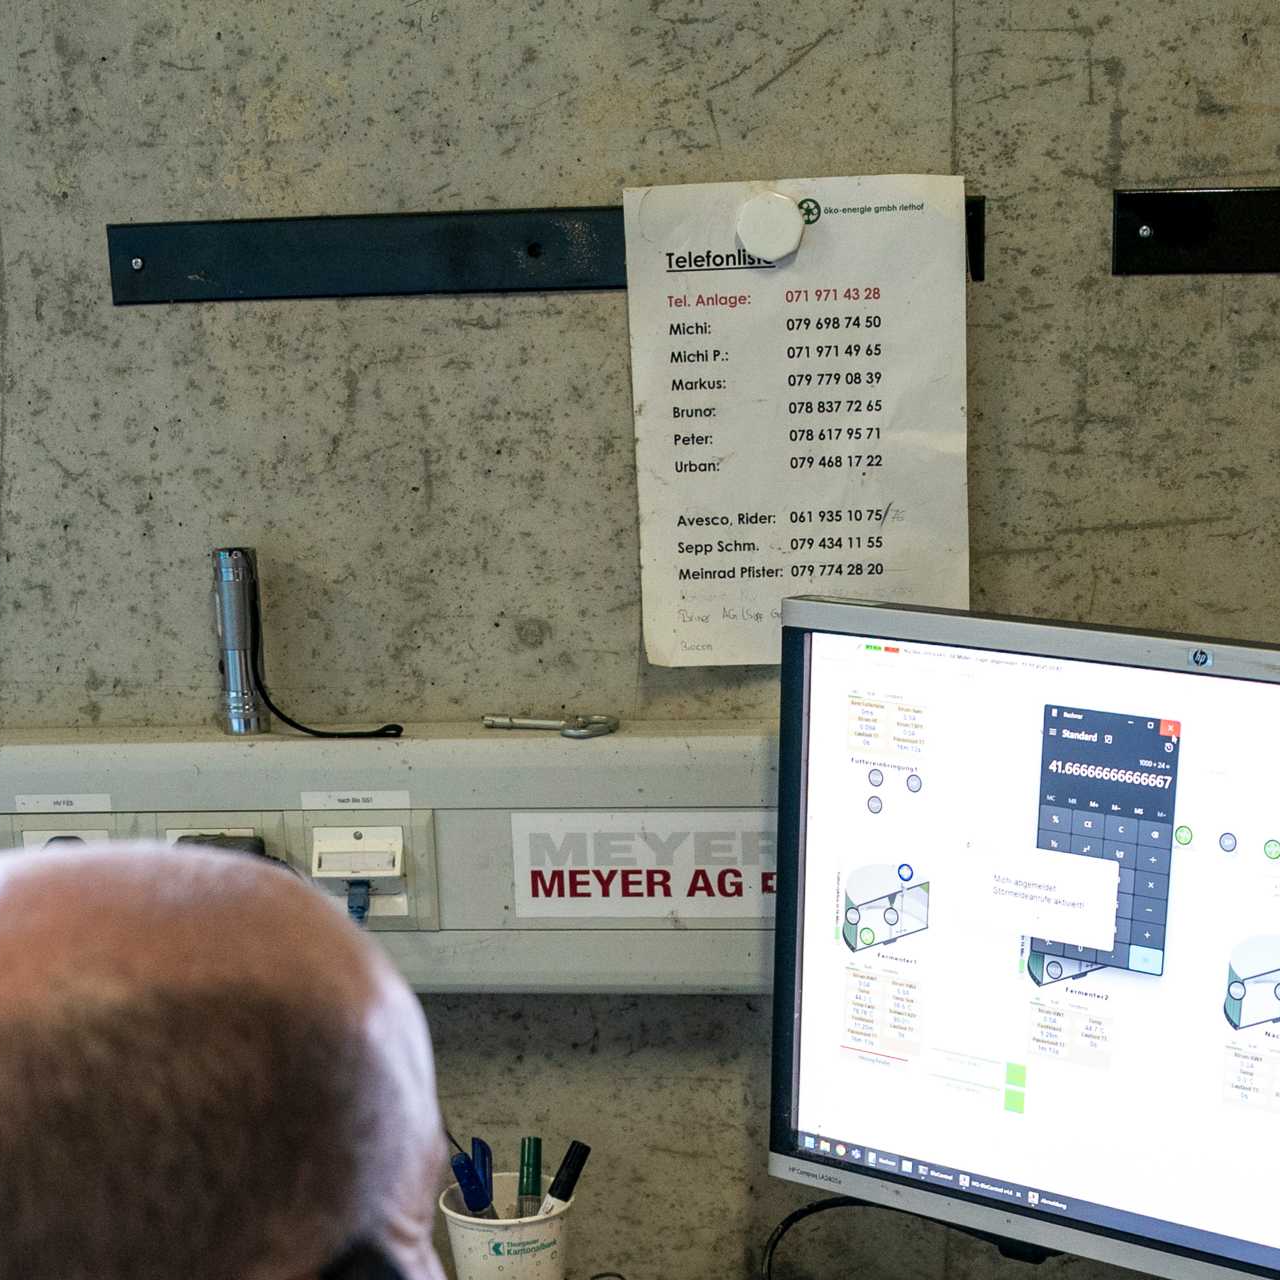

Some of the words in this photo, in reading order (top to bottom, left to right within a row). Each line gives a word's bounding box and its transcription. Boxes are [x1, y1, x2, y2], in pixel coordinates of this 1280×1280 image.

[873, 204, 898, 214] gmbh
[667, 294, 691, 308] Tel.
[695, 293, 751, 309] Anlage:
[785, 289, 809, 303] 071
[814, 288, 837, 302] 971
[843, 287, 861, 301] 43
[863, 287, 881, 301] 28
[669, 321, 711, 336] Michi:
[786, 317, 811, 331] 079
[815, 316, 841, 331] 698
[844, 315, 861, 329] 74
[865, 315, 882, 329] 50
[669, 349, 709, 364] Michi
[713, 349, 729, 362] P.:
[787, 345, 810, 359] 071
[815, 345, 839, 358] 971
[844, 343, 861, 357] 49
[865, 343, 882, 357] 65
[671, 377, 727, 391] Markus:
[787, 373, 813, 387] 079
[816, 372, 841, 386] 779
[845, 371, 862, 385] 08
[865, 371, 882, 385] 39
[672, 406, 717, 419] Bruno:
[788, 401, 814, 415] 078
[817, 400, 842, 414] 837
[845, 399, 863, 413] 72
[866, 399, 883, 412] 65
[673, 433, 713, 446] Peter:
[789, 428, 815, 442] 078
[818, 428, 843, 441] 617
[846, 427, 862, 441] 95
[866, 427, 881, 440] 71
[675, 460, 720, 473] Urban:
[789, 455, 815, 470] 079
[818, 455, 843, 468] 468
[847, 455, 863, 468] 17
[866, 454, 883, 467] 22
[677, 515, 733, 527] Avesco,
[737, 512, 776, 525] Rider:
[789, 511, 813, 524] 061
[818, 509, 843, 523] 935
[847, 509, 863, 522] 10
[677, 541, 713, 556] Sepp
[717, 539, 760, 553] Schm.
[790, 537, 815, 551] 079
[818, 537, 843, 550] 434
[847, 536, 861, 549] 11
[866, 535, 883, 549] 55
[678, 566, 736, 581] Meinrad
[740, 565, 784, 579] Pfister:
[790, 564, 815, 577] 079
[819, 563, 843, 577] 774
[847, 563, 864, 576] 28
[867, 563, 884, 575] 20
[1192, 650, 1208, 667] hp
[1062, 729, 1098, 743] Standard
[528, 831, 777, 866] MEYER
[530, 869, 672, 898] MEYER
[686, 868, 743, 898] AG
